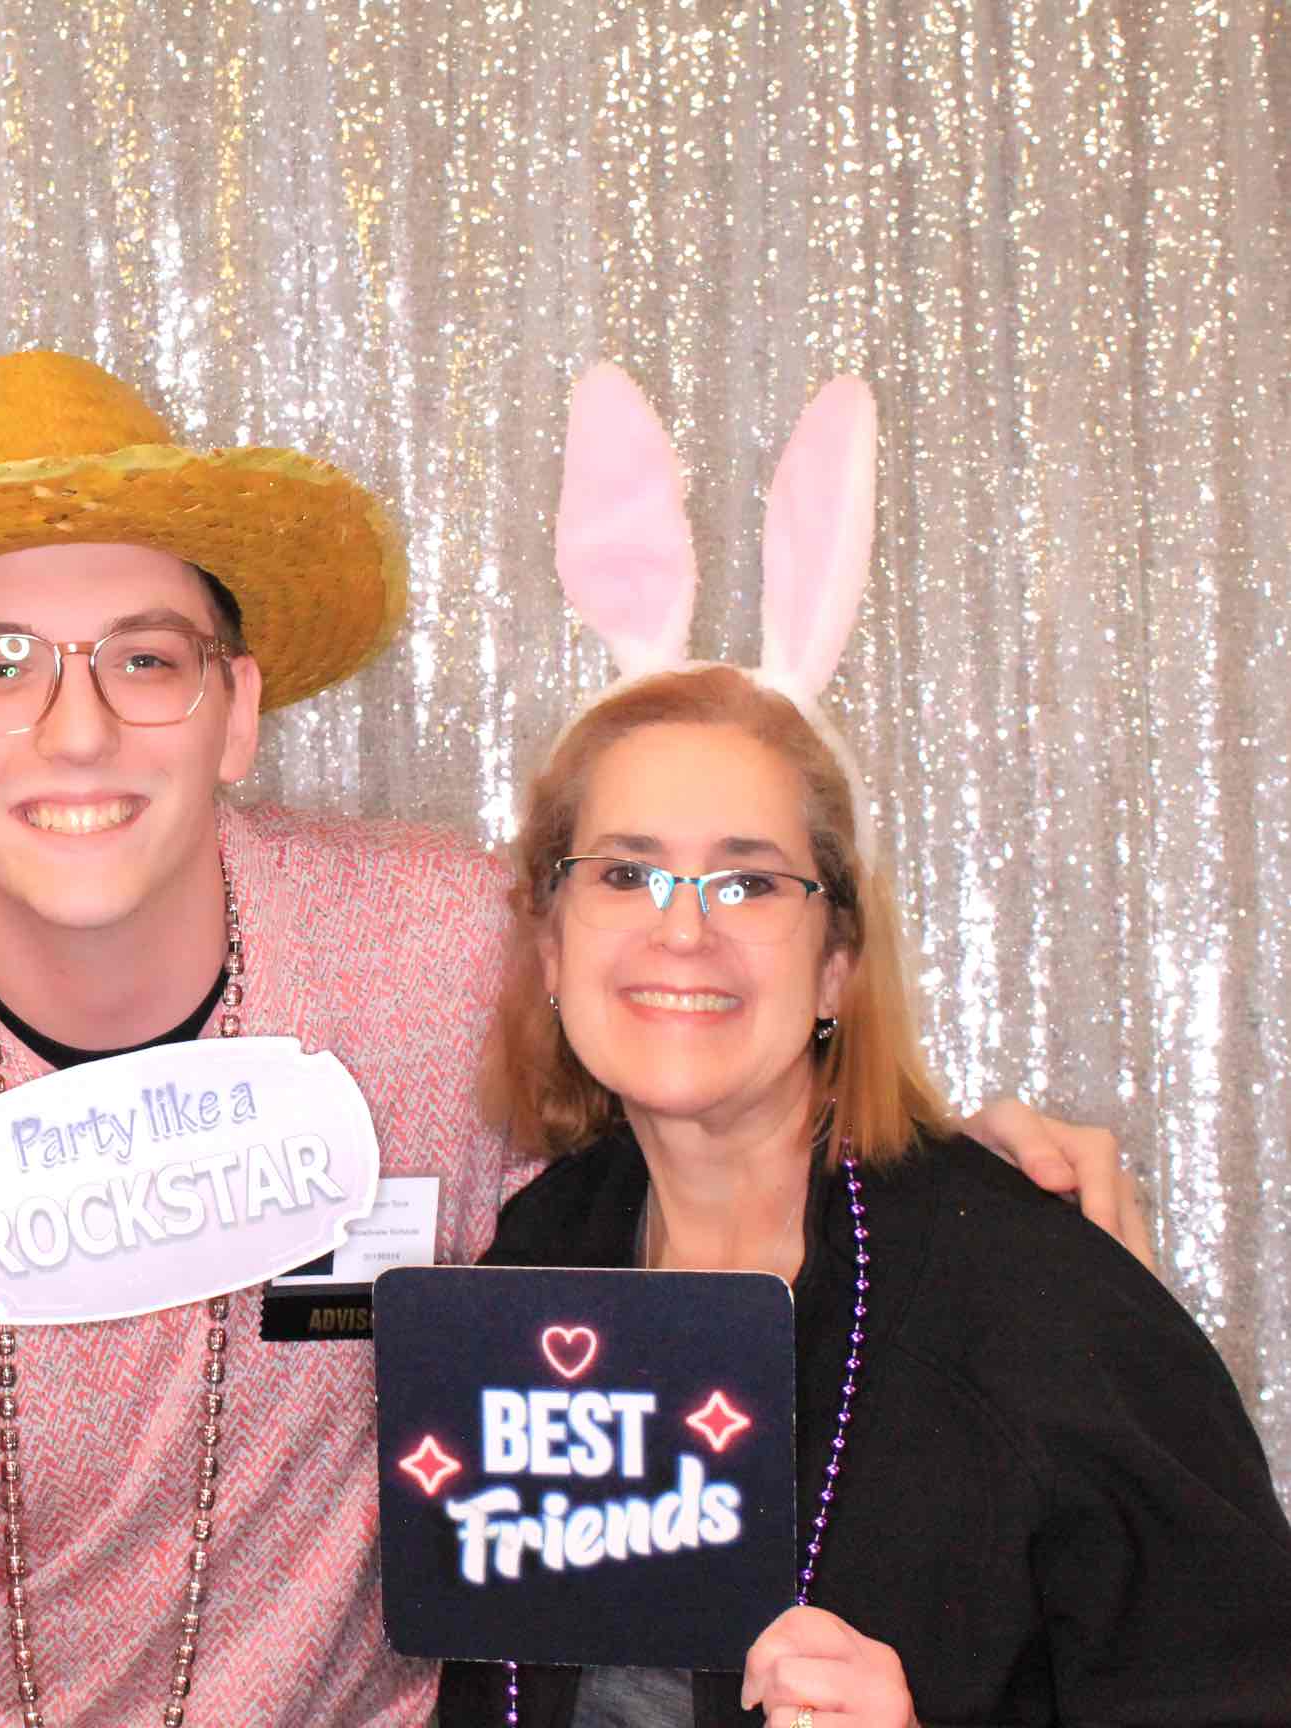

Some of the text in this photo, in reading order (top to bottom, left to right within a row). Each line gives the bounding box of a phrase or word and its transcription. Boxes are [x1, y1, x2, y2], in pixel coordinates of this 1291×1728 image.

[10, 1080, 258, 1173] Party like a
[309, 1307, 373, 1331] ADVIS
[480, 1388, 657, 1479] BEST
[445, 1454, 743, 1585] Friends
